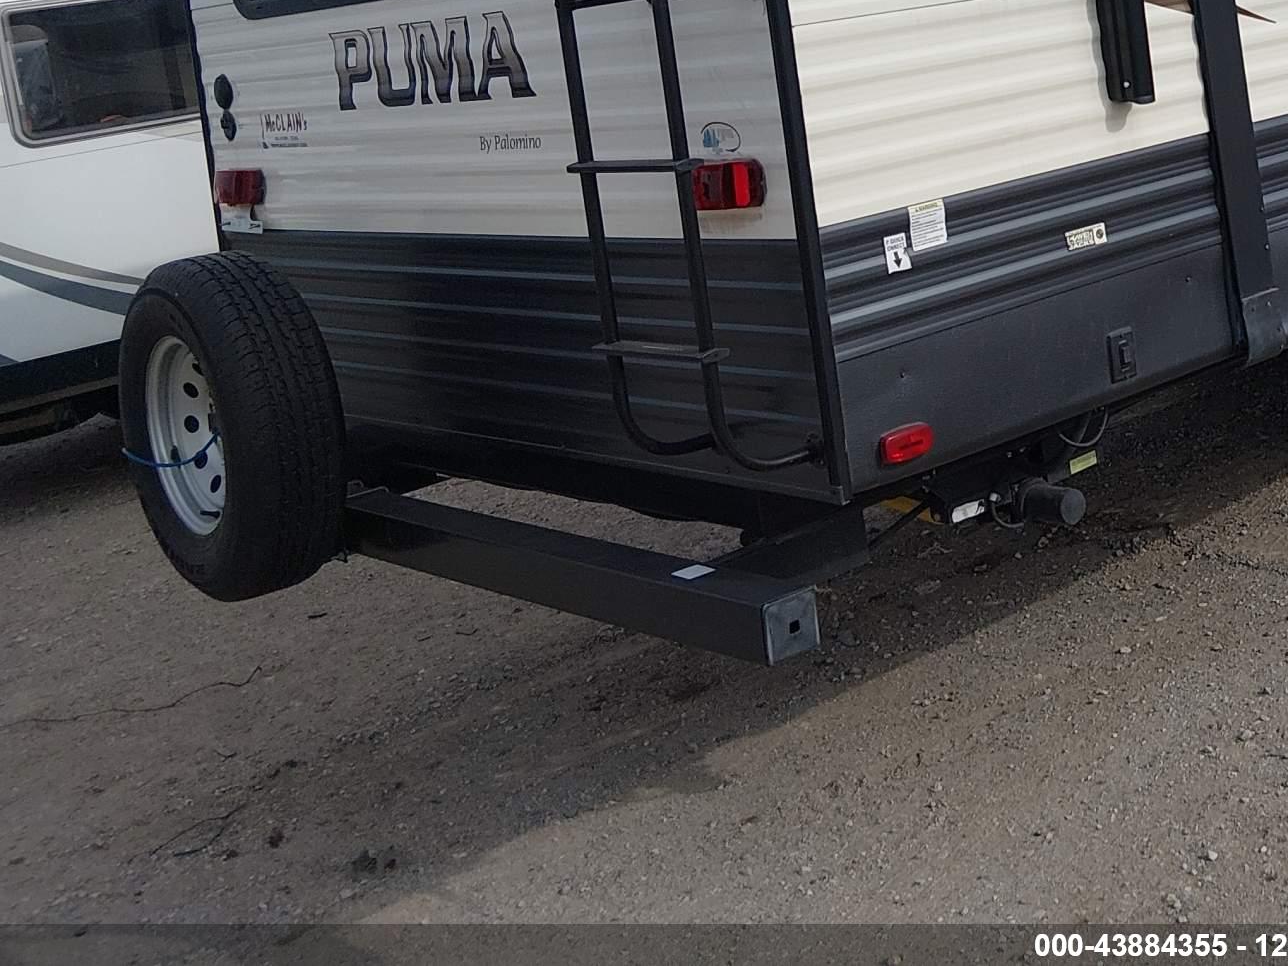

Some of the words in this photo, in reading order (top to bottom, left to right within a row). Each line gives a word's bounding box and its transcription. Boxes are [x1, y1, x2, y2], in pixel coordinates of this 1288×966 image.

[329, 10, 537, 111] PUMA
[479, 136, 492, 154] By
[494, 135, 542, 151] Palomino
